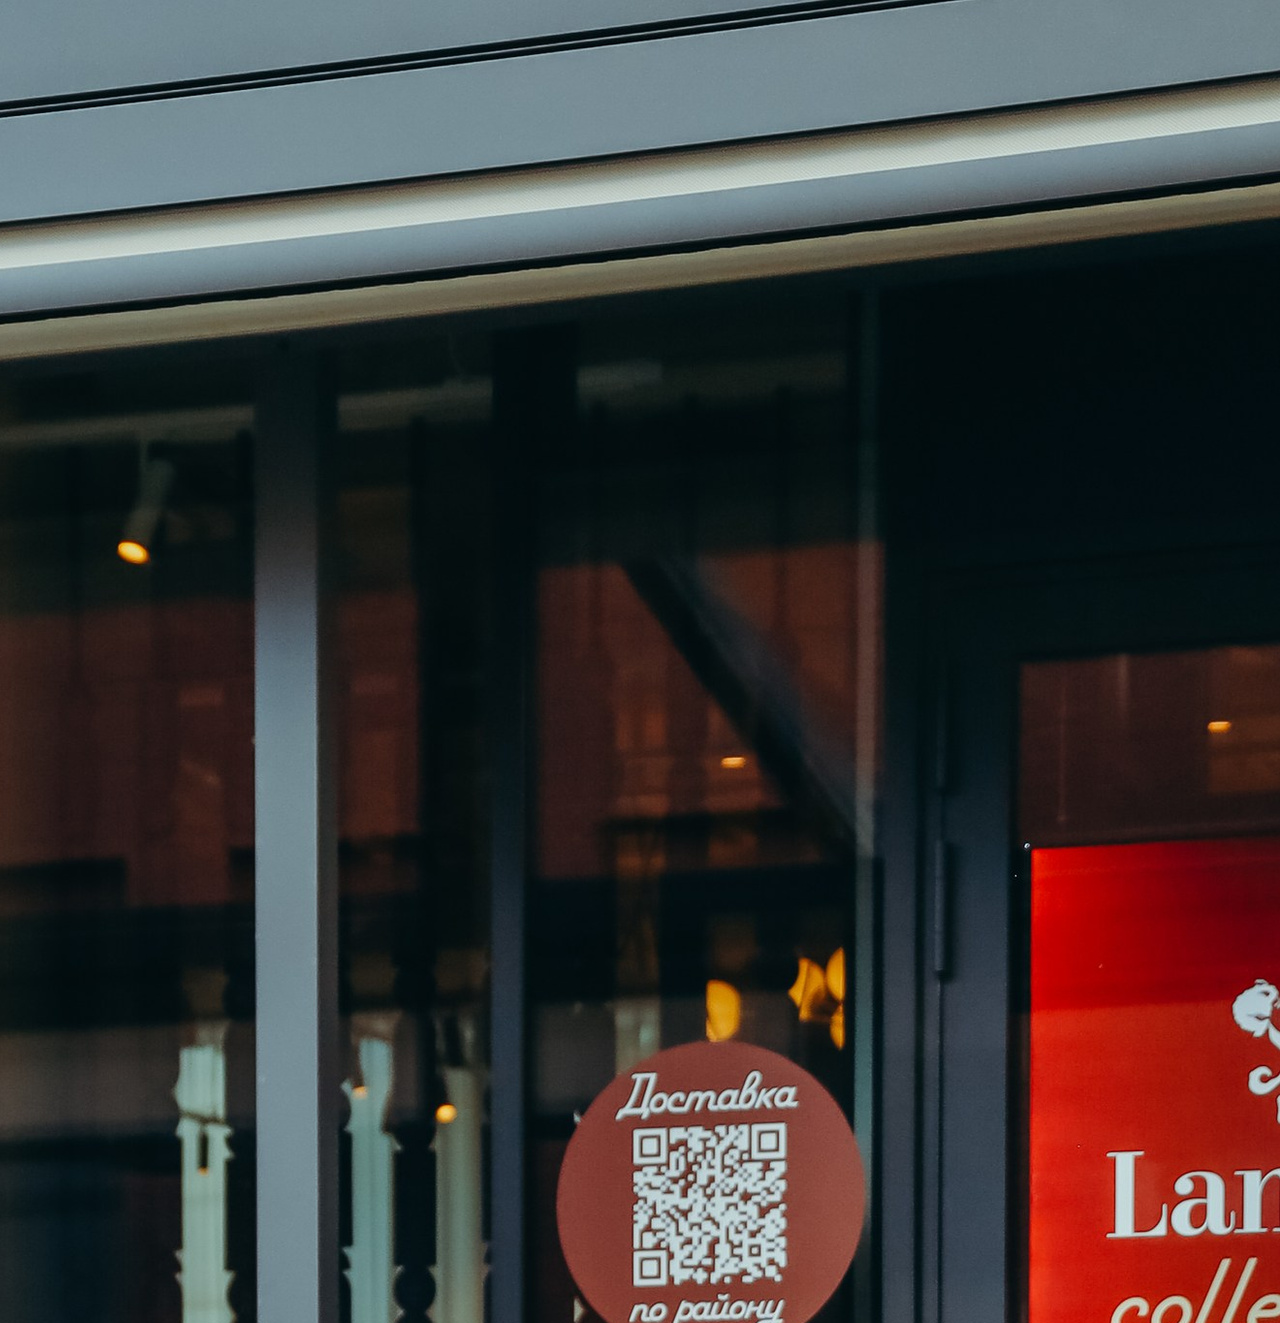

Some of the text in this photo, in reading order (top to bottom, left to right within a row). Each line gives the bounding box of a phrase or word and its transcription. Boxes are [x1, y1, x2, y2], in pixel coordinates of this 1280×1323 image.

[615, 1069, 799, 1121] Доставка
[1106, 1150, 1280, 1238] Lan
[628, 1302, 668, 1323] по
